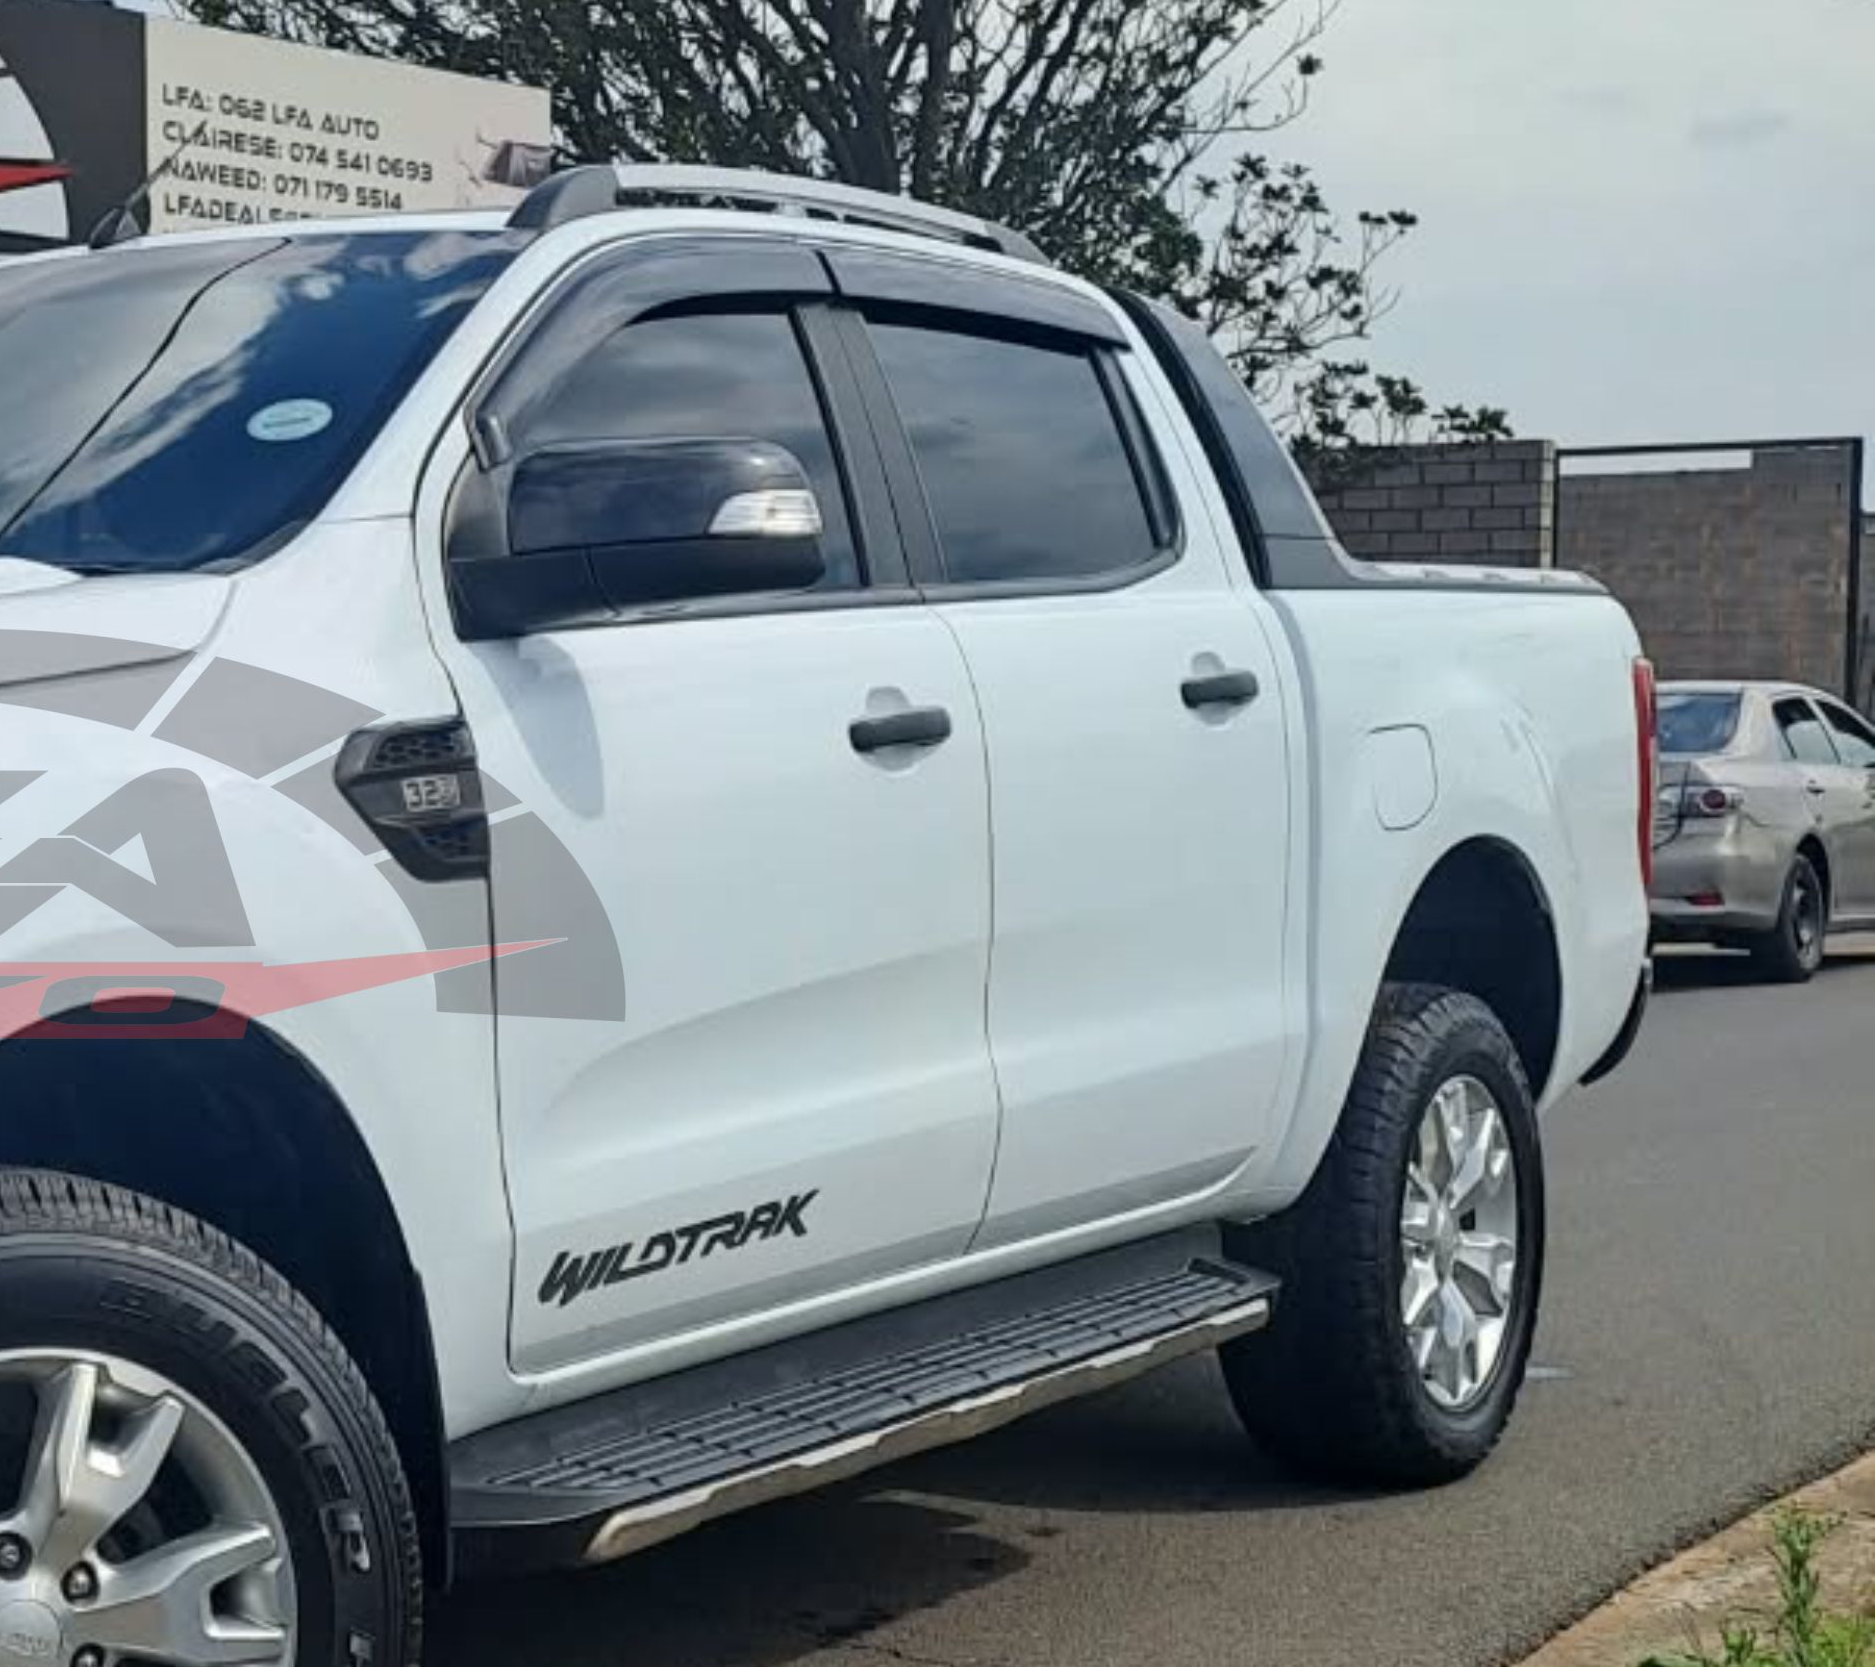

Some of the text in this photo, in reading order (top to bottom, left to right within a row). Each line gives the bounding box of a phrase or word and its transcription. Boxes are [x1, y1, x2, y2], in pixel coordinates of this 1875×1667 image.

[162, 82, 212, 113] LFA:
[272, 102, 313, 130] LFA
[320, 111, 380, 141] AUTO
[162, 120, 433, 182] CLAIRESE: 074 541 0693
[274, 173, 309, 199] 071
[314, 179, 349, 204] 179
[355, 185, 402, 210] 5514
[538, 1188, 820, 1308] WILDTRAK
